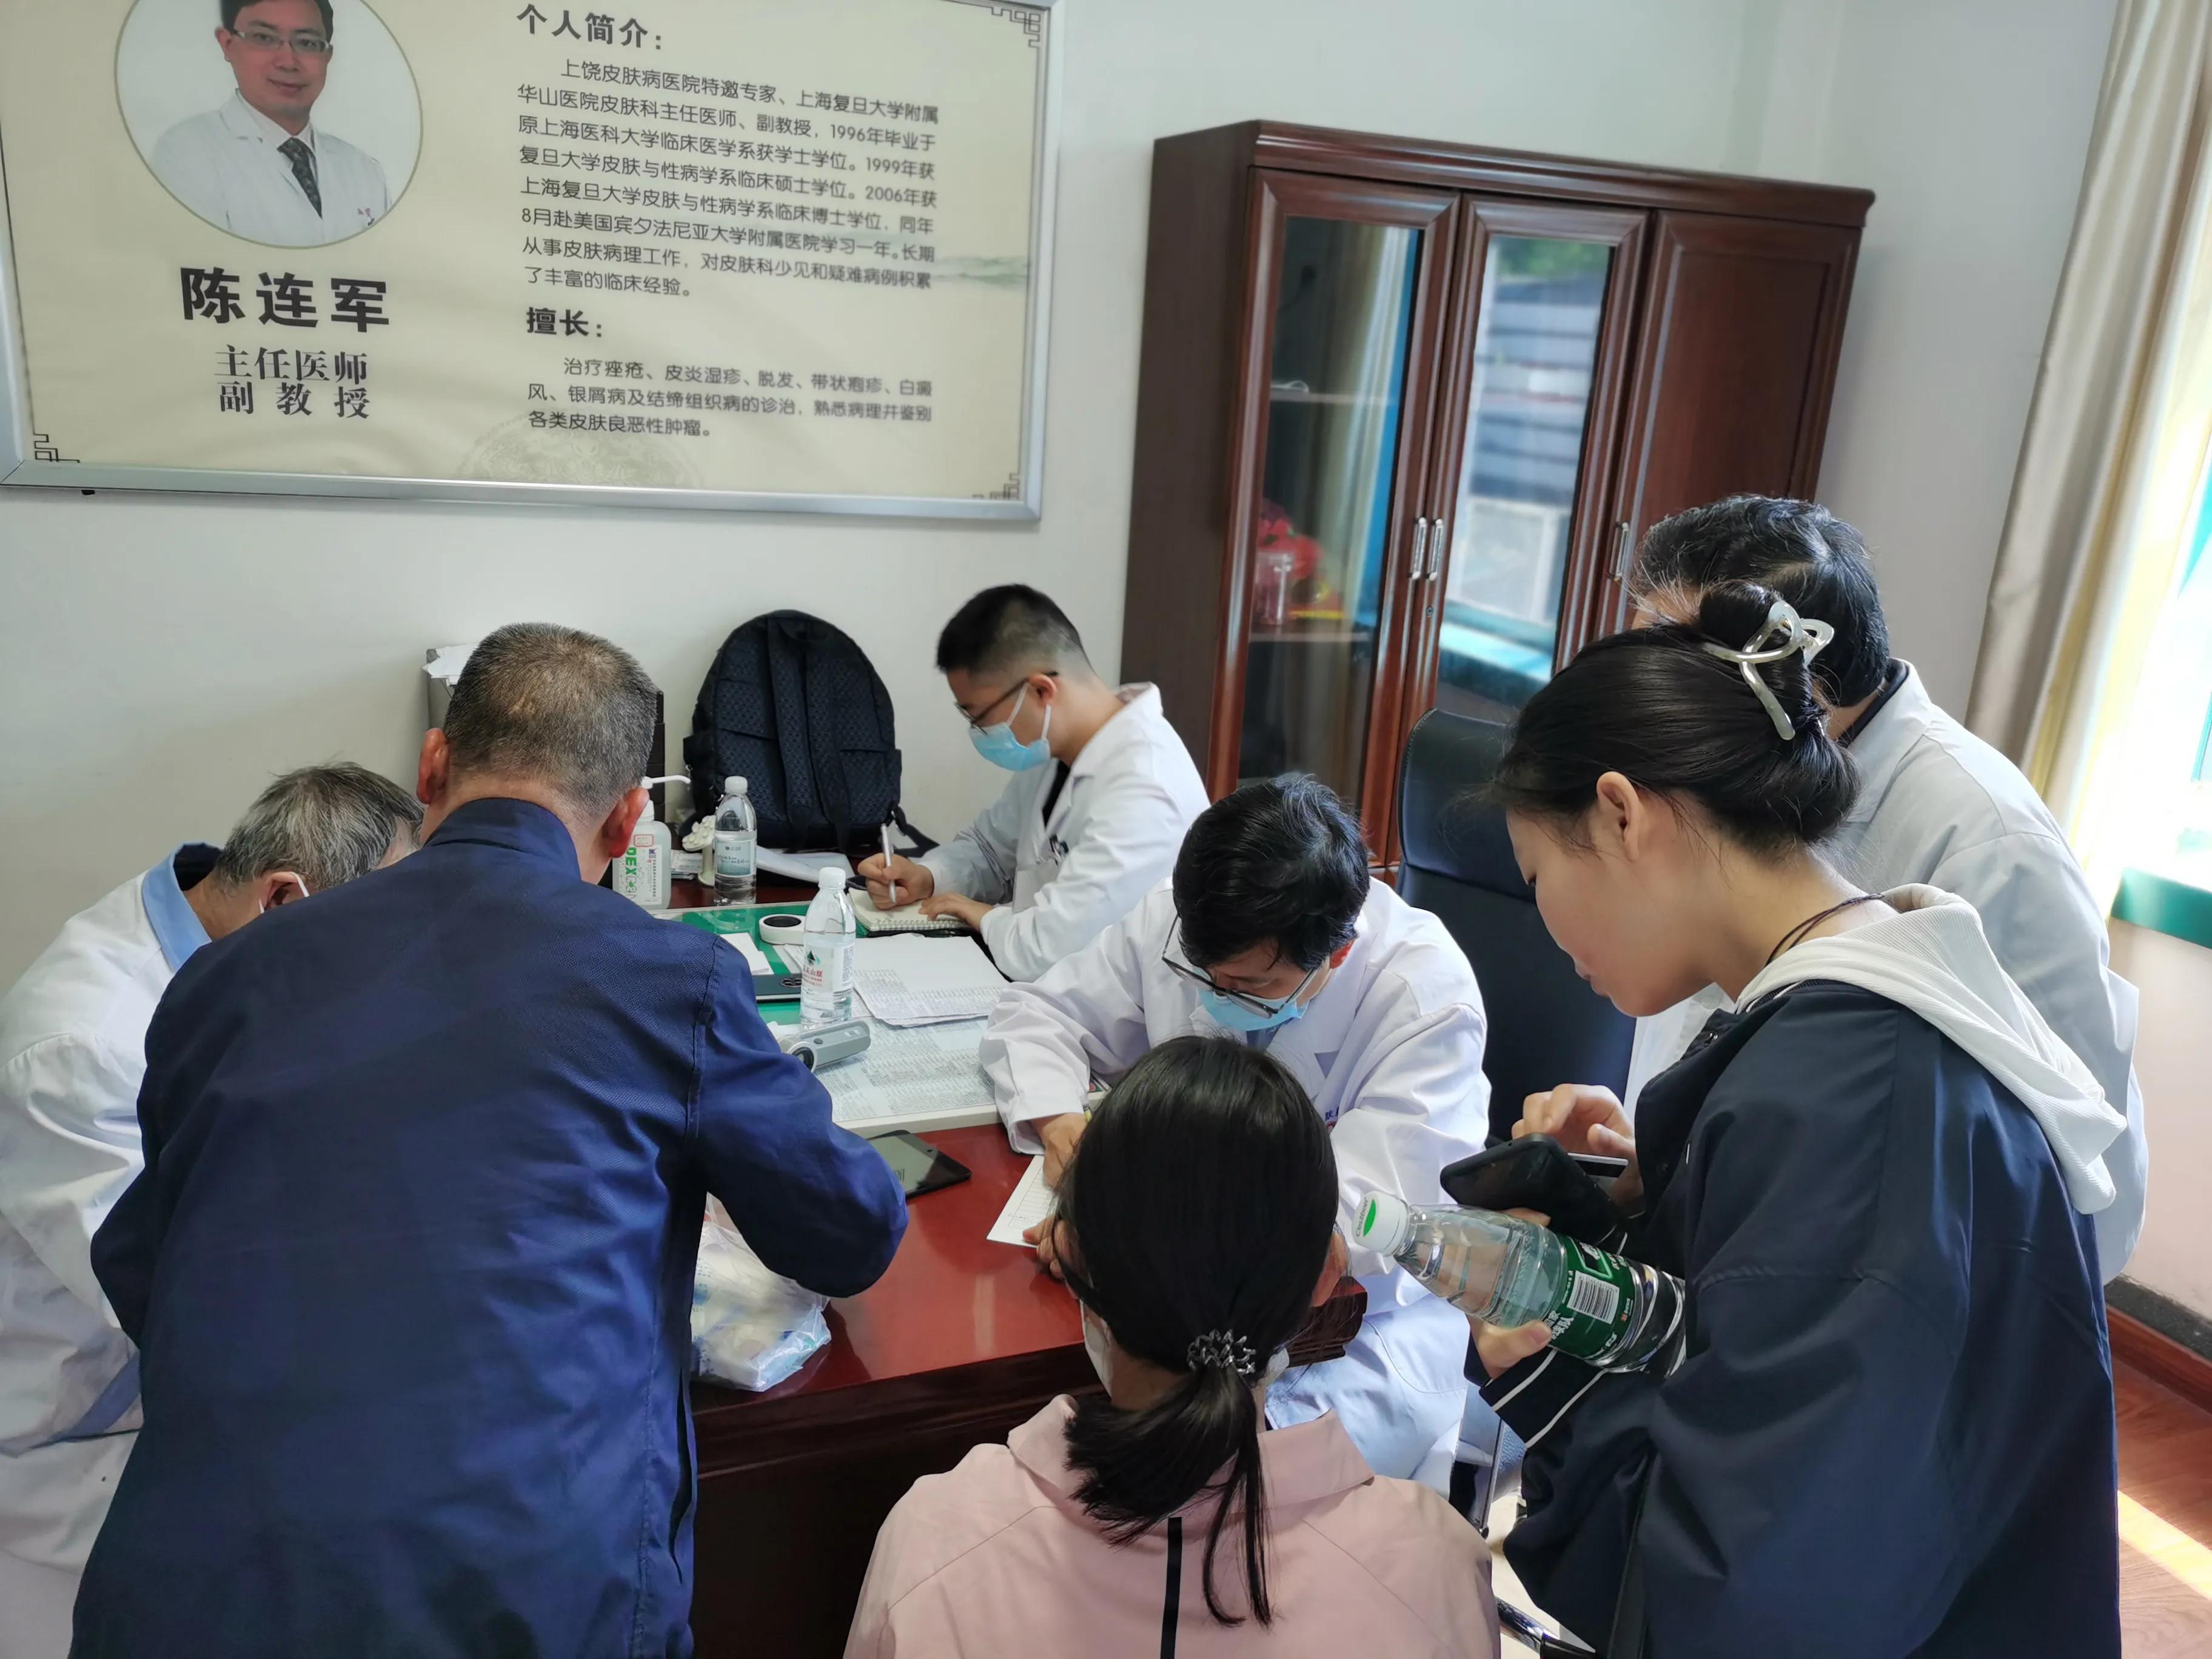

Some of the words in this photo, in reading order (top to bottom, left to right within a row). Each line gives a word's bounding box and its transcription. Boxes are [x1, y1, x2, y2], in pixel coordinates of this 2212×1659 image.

[561, 59, 939, 124] 上饶皮肤病医院特邀专家、上海复旦大学附属
[179, 266, 390, 333] 陈连军
[525, 266, 690, 298] 了丰富的临床经验。
[213, 344, 367, 385] 主任医师
[218, 381, 370, 419] 副教授
[528, 411, 710, 437] 各类皮肤良恶性肿瘤。
